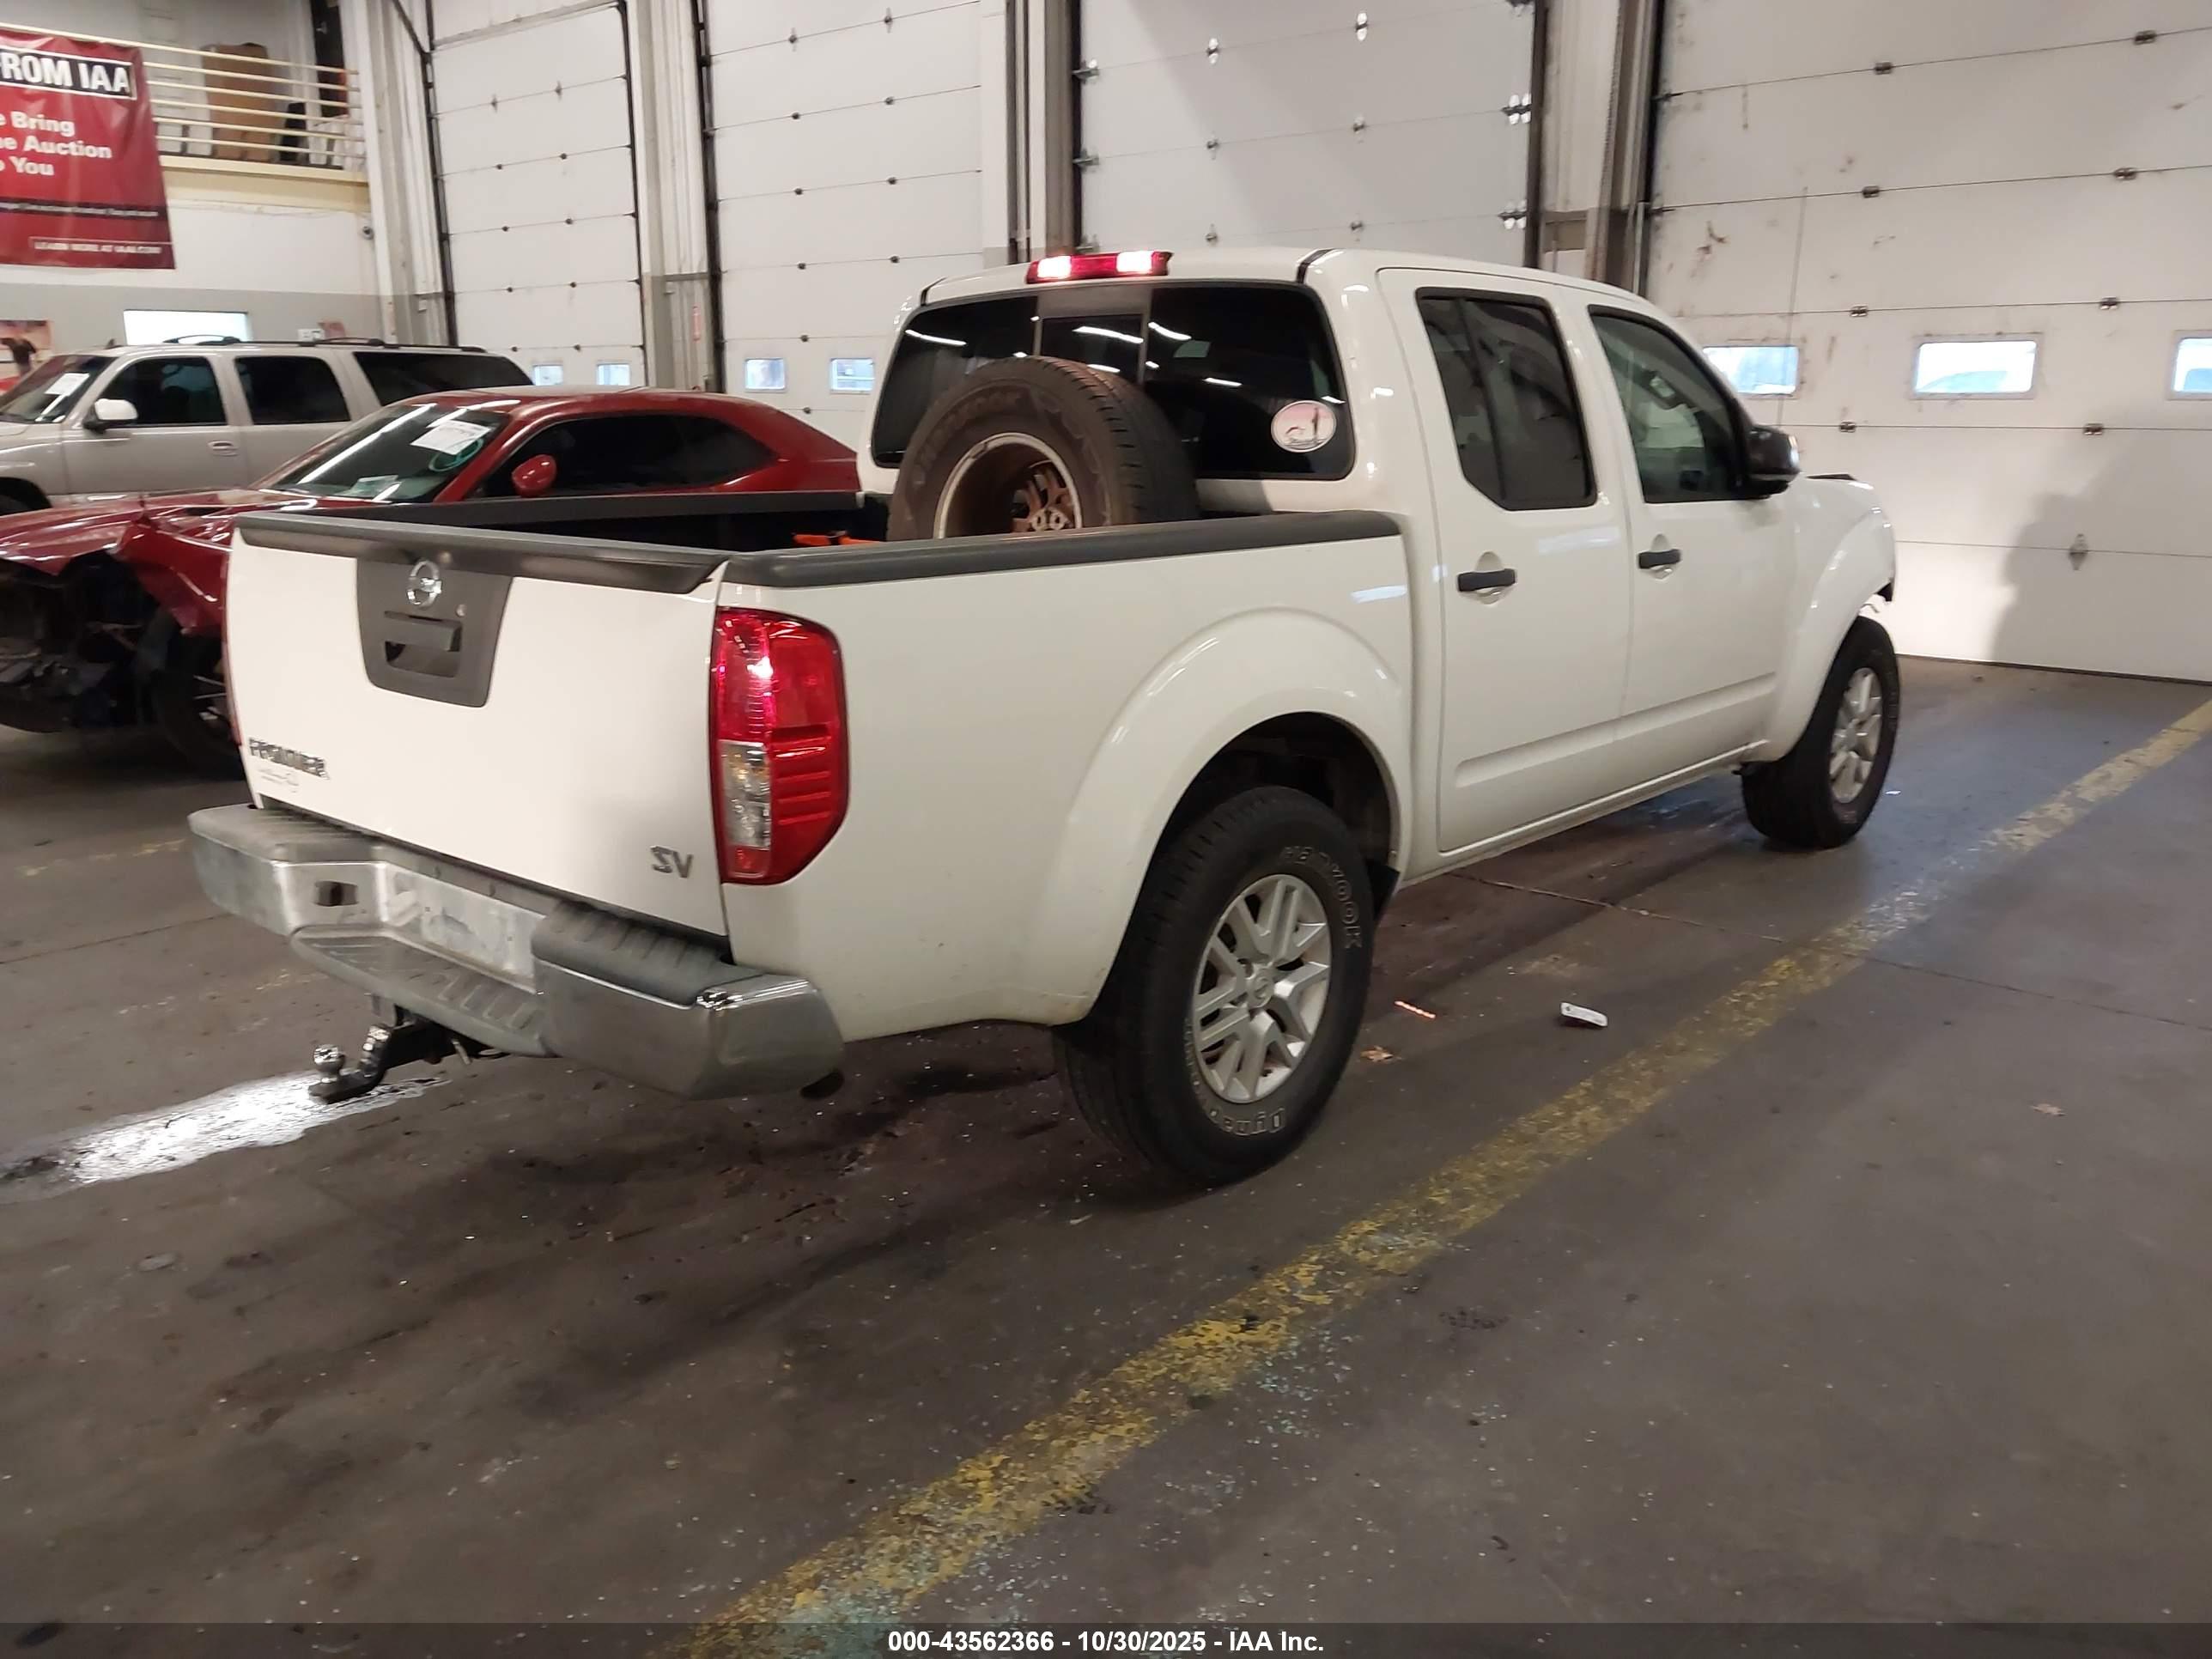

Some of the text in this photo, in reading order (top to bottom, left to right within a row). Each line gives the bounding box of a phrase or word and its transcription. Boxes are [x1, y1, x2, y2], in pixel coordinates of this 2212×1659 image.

[0, 52, 131, 94] ROM IAA
[10, 111, 76, 137] Bring
[23, 135, 112, 159] Auction
[9, 155, 55, 176] You
[650, 846, 693, 878] SV
